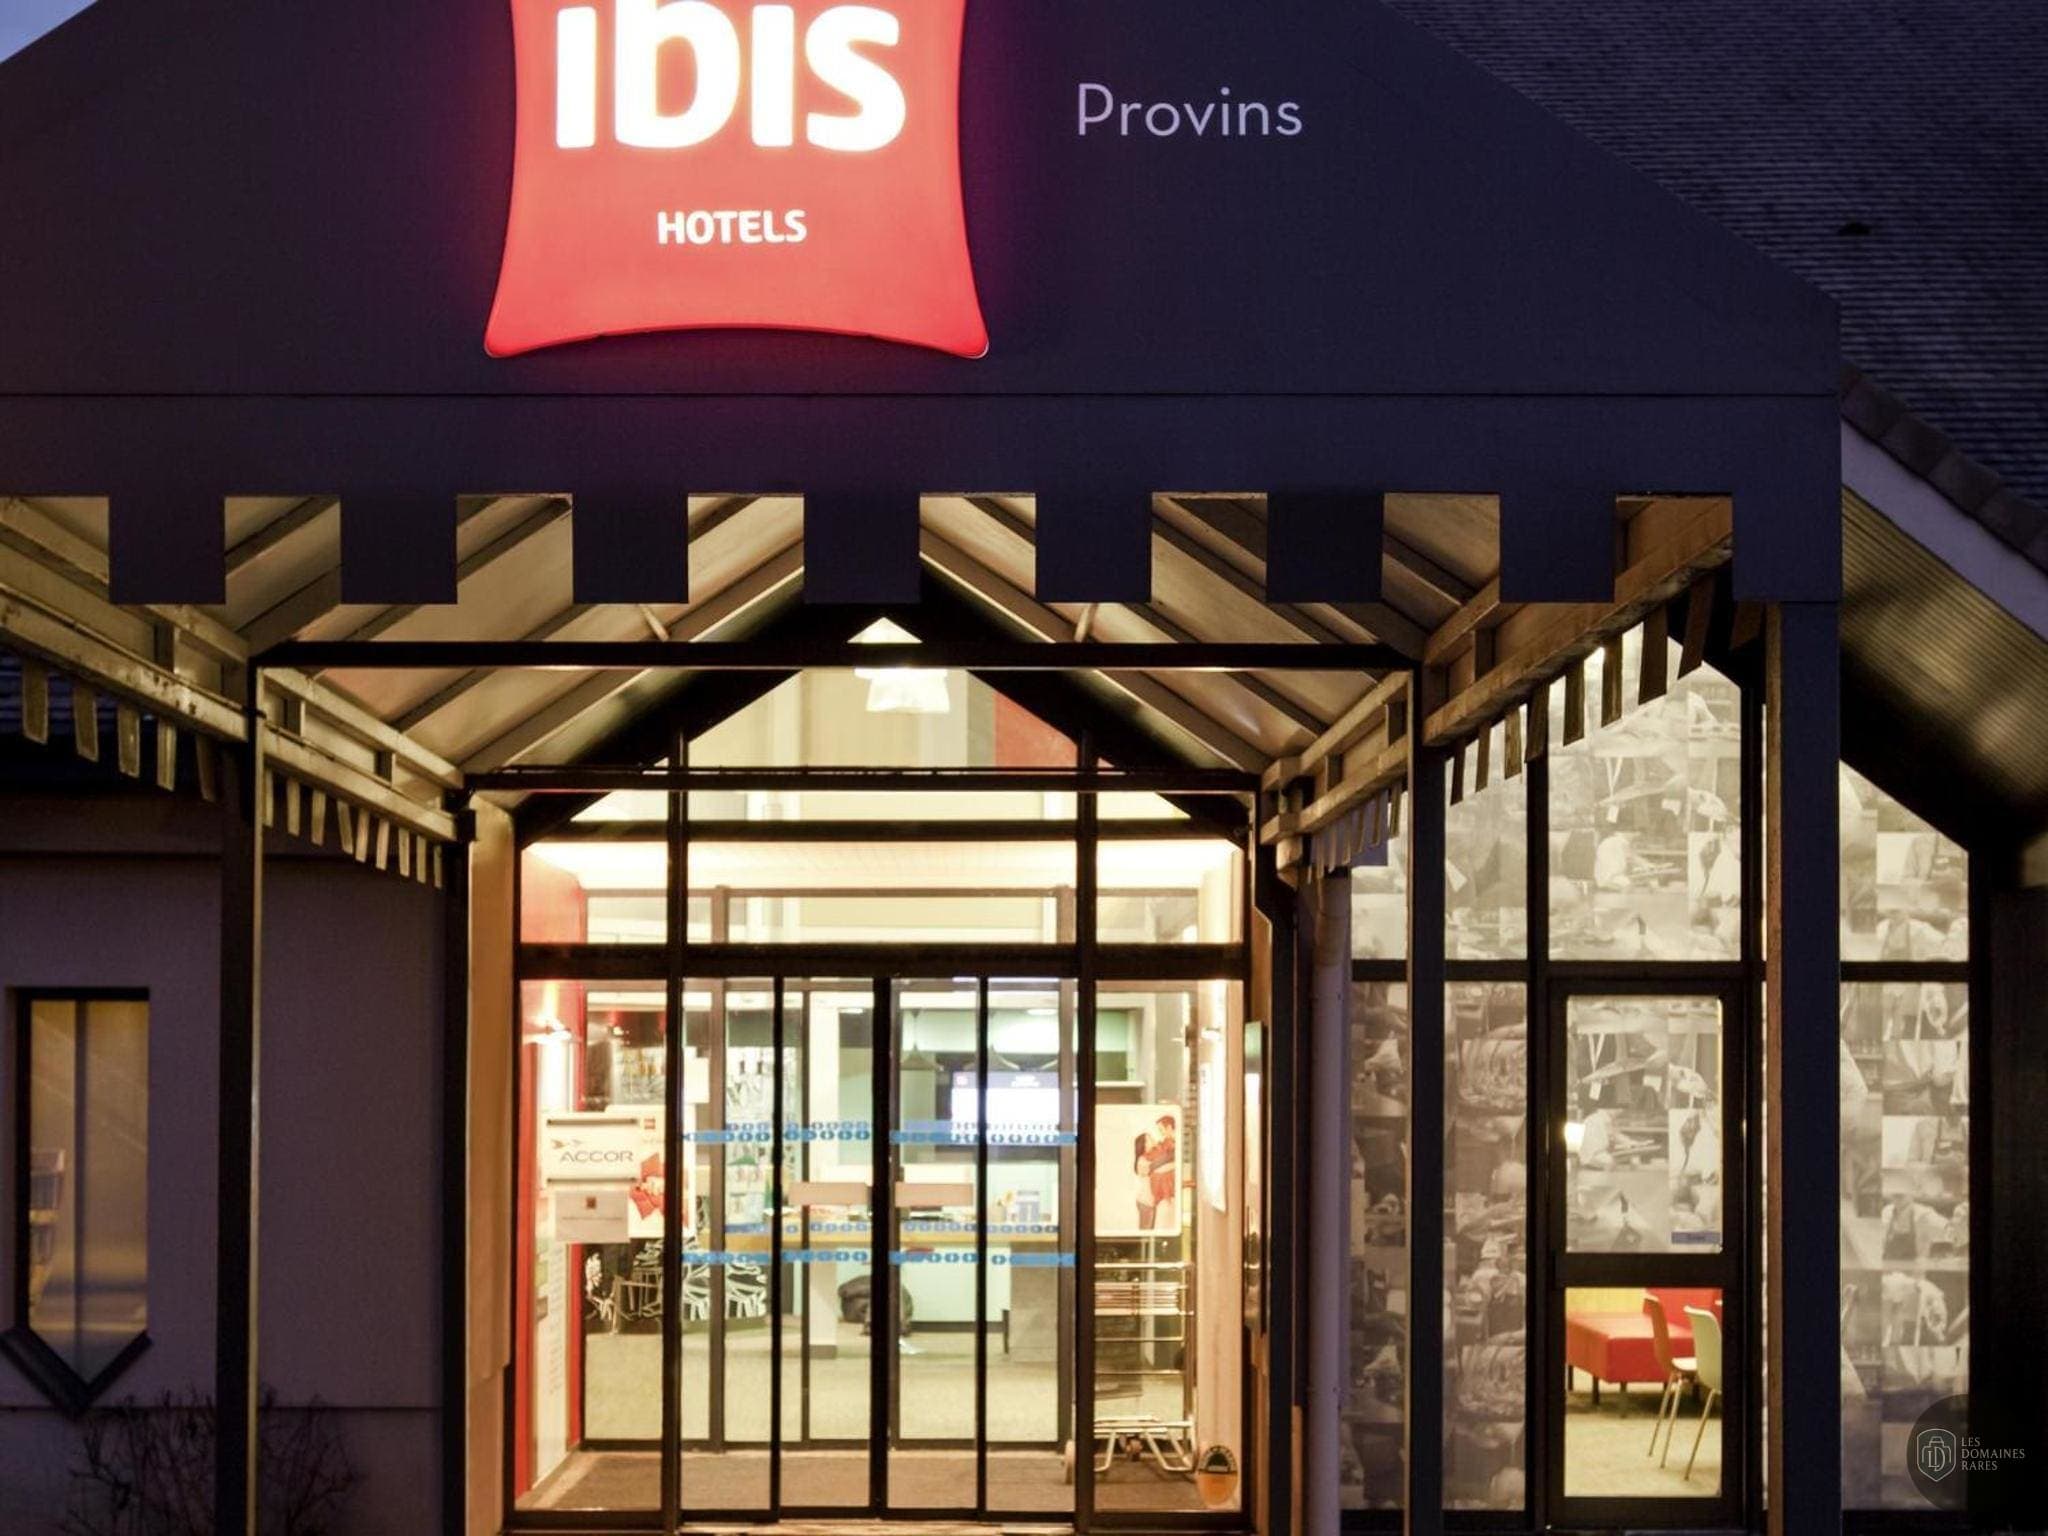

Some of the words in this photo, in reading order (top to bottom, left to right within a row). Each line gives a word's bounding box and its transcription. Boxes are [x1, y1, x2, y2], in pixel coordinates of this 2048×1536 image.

[554, 0, 907, 151] ibis
[1077, 83, 1303, 138] Provins
[657, 210, 807, 244] HOTELS
[560, 1150, 634, 1164] ACCOR
